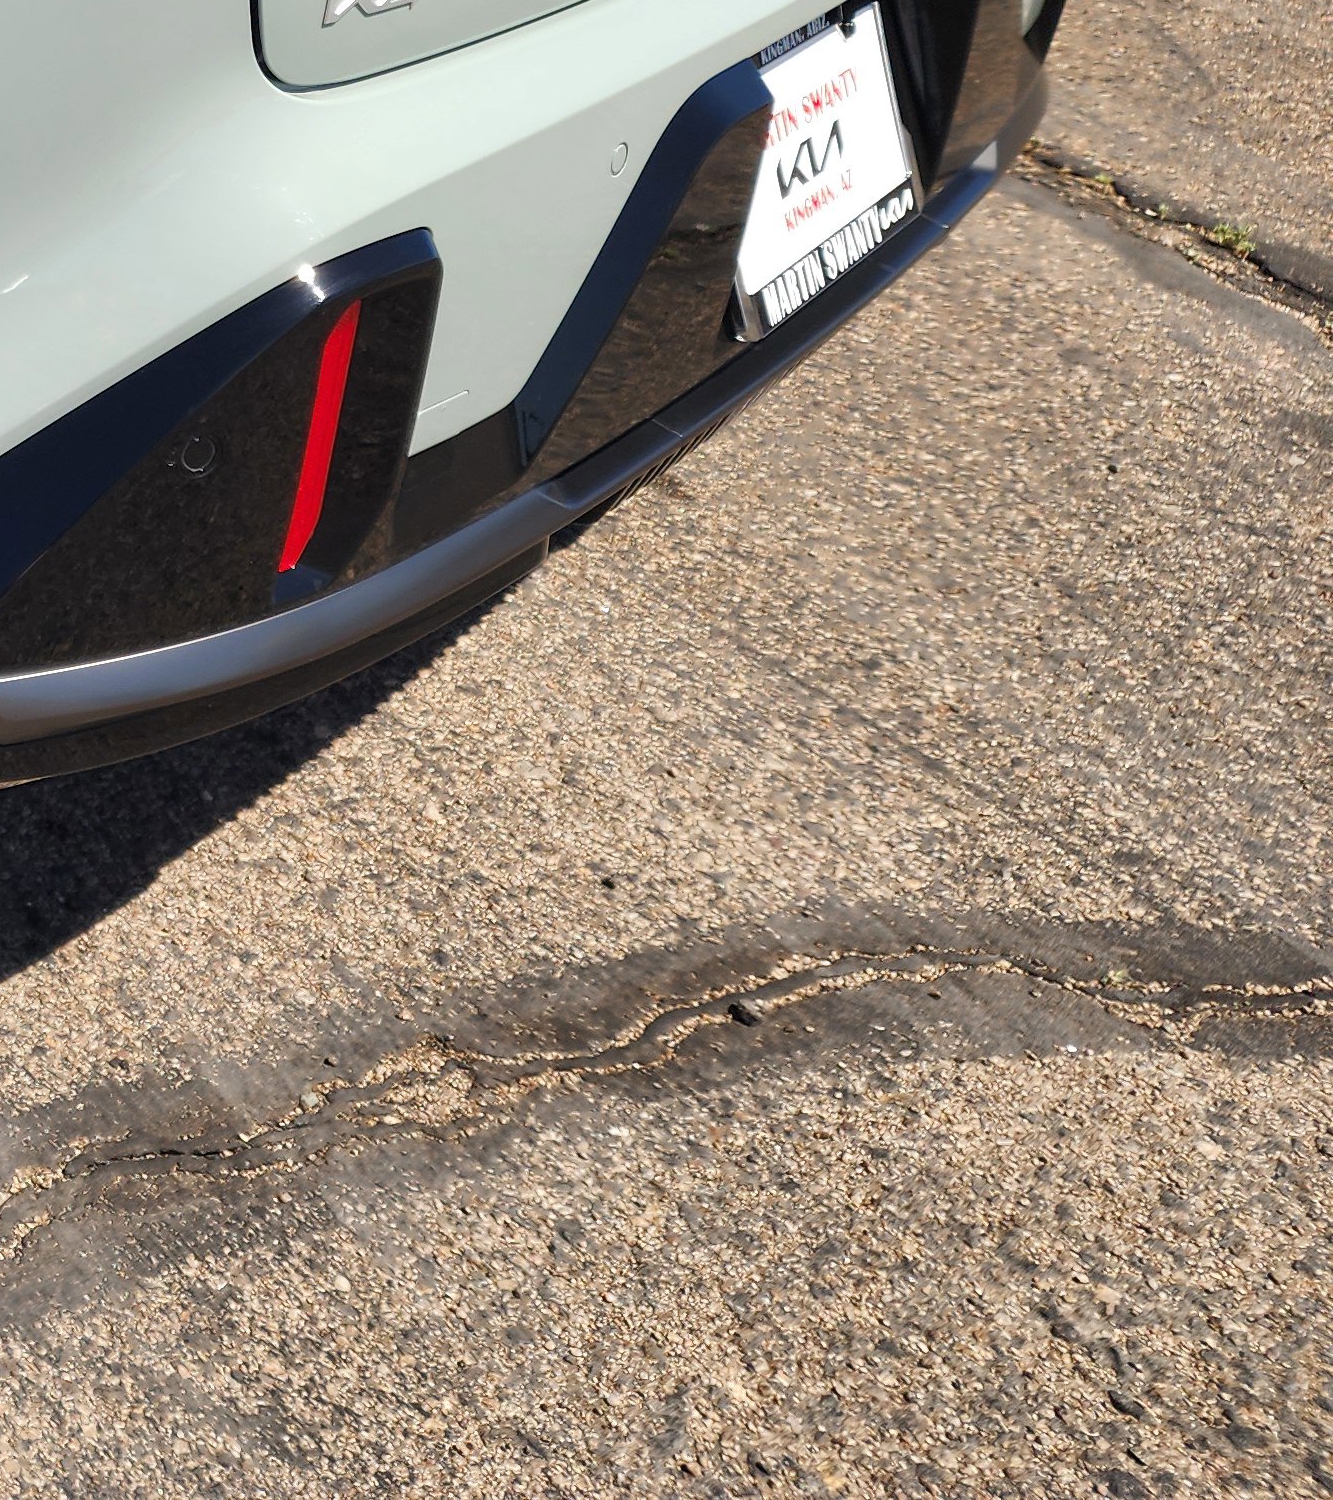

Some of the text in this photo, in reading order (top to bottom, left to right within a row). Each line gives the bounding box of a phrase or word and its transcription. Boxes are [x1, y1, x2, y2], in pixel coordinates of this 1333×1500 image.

[802, 66, 857, 123] SWANTY
[777, 119, 843, 200] KIA
[841, 168, 852, 191] AZ
[761, 250, 826, 328] MARTIN
[821, 205, 883, 280] SWANTY
